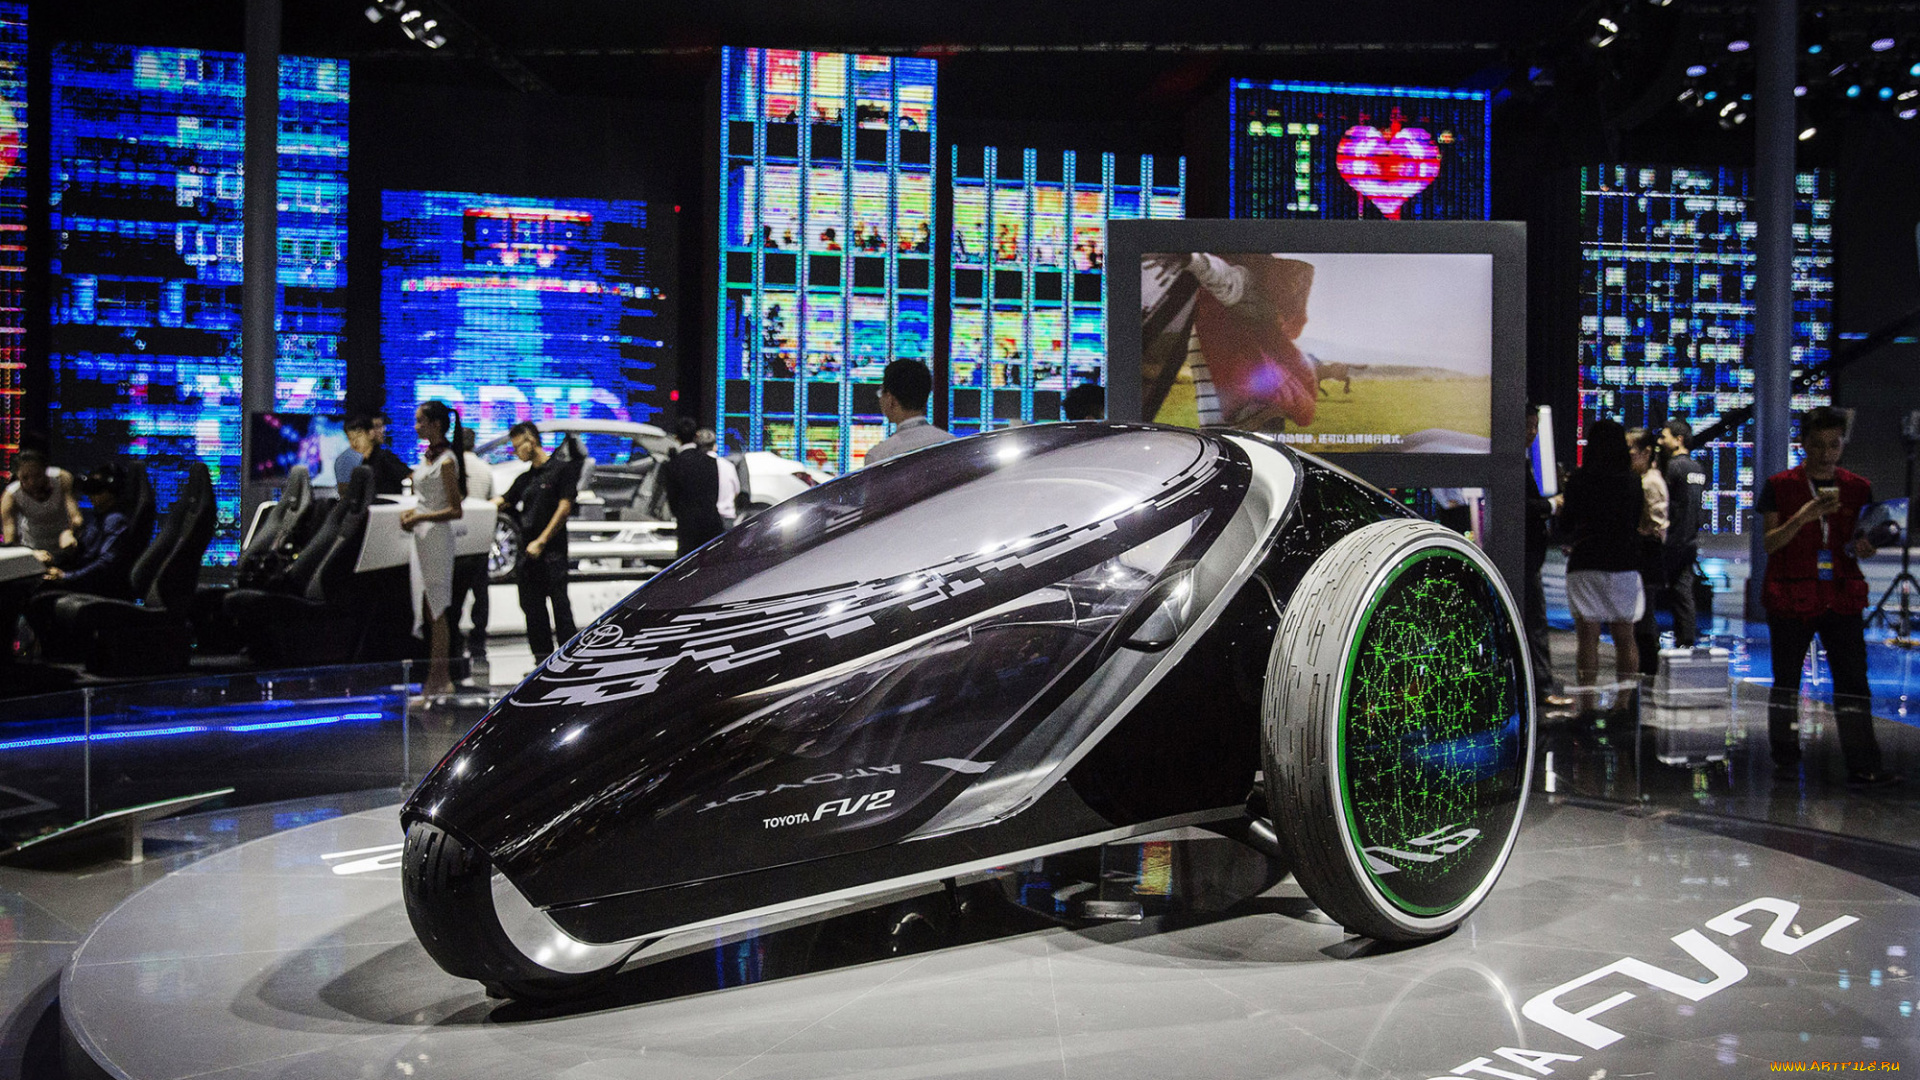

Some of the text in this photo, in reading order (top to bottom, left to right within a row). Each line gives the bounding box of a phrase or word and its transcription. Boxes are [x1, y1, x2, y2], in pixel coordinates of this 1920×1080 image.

[763, 789, 895, 829] TOYOTA FV2
[1426, 897, 1860, 1080] TA FV2
